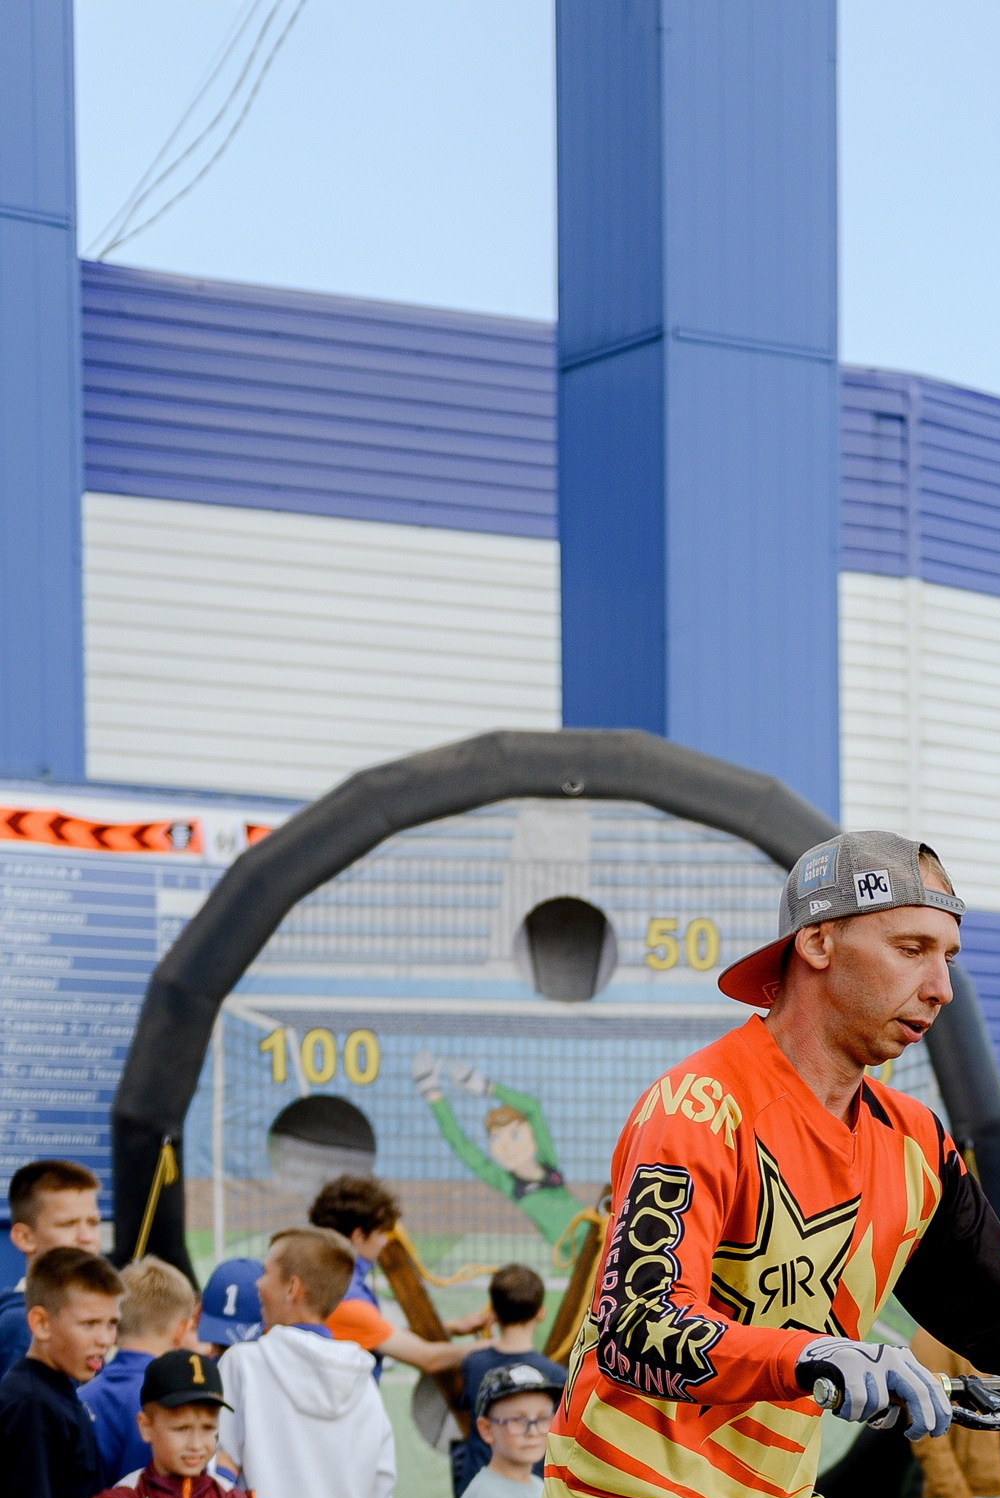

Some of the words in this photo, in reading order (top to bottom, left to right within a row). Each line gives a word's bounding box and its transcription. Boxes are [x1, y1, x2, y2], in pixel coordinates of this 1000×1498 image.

[804, 864, 828, 882] bakery
[806, 855, 829, 870] natures
[644, 917, 720, 972] 50
[259, 1026, 380, 1085] 100
[224, 1284, 238, 1316] 1
[188, 1355, 206, 1385] 1
